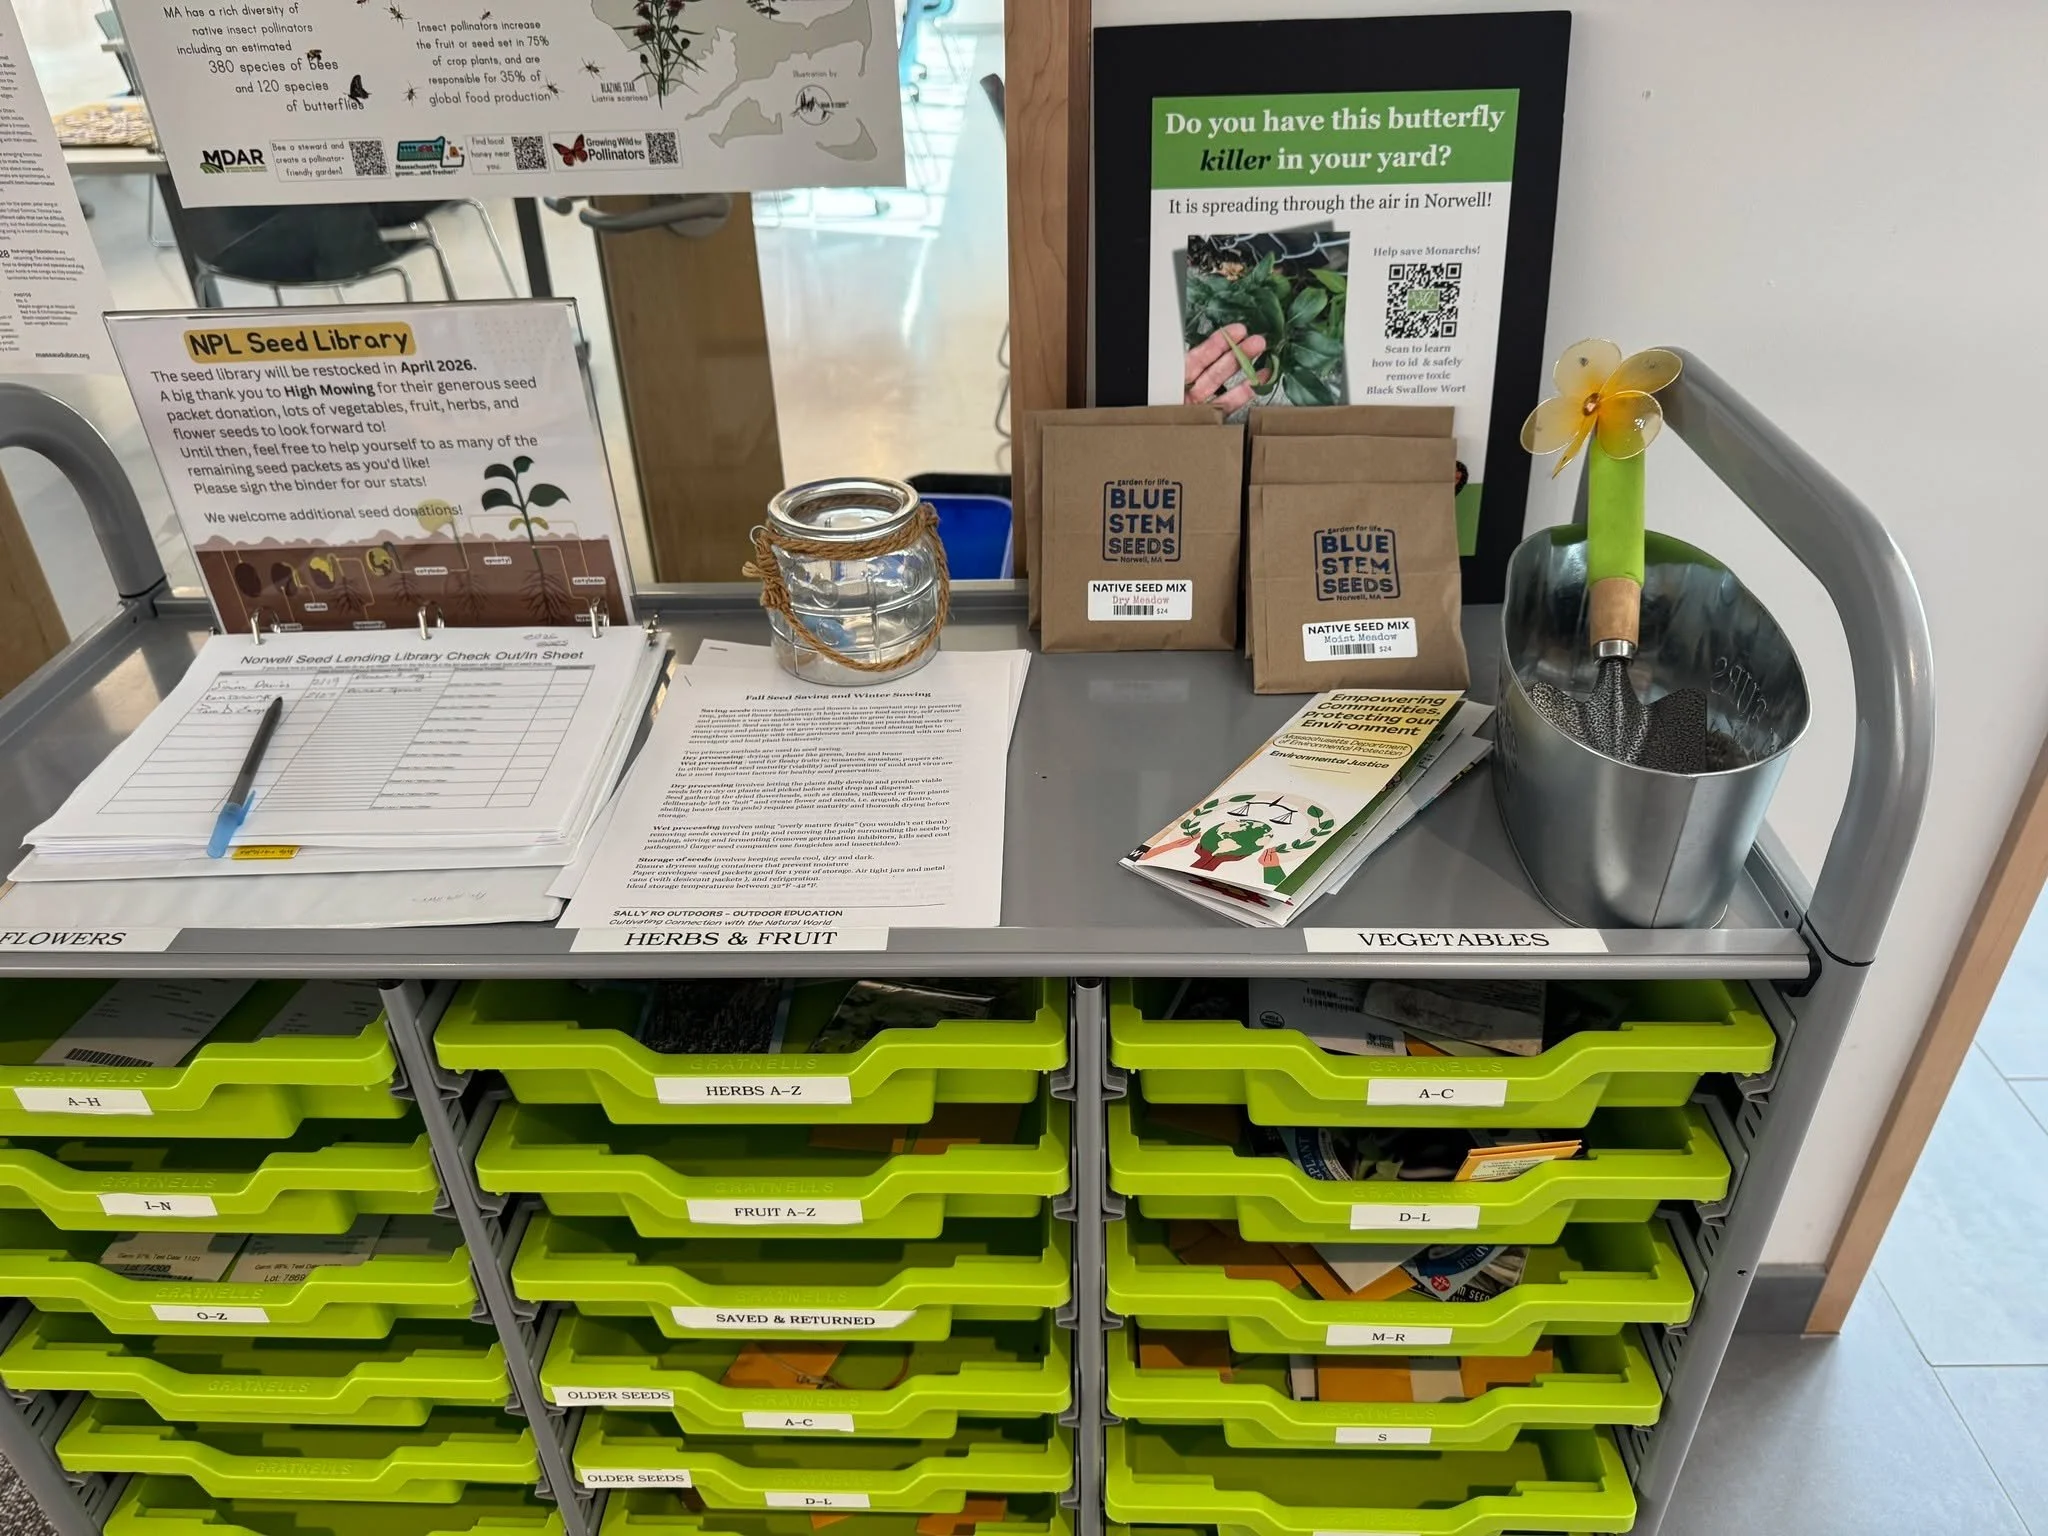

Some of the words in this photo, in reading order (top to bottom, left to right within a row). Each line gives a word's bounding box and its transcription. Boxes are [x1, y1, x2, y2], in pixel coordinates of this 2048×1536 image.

[417, 21, 446, 32] Insect
[451, 20, 498, 33] pollinators
[502, 21, 541, 30] increase
[209, 60, 234, 73] 380
[240, 60, 285, 75] species
[291, 58, 302, 70] of
[309, 58, 338, 70] bees
[236, 83, 253, 93] and
[258, 80, 279, 92] 120
[285, 82, 328, 95] species
[430, 94, 461, 107] global
[466, 92, 490, 103] food
[1165, 113, 1202, 135] Do
[1208, 115, 1255, 139] you
[1263, 110, 1324, 132] have
[1331, 108, 1381, 131] this
[1388, 104, 1505, 132] butterfly
[586, 138, 616, 148] Growing
[619, 137, 633, 146] Wild
[203, 149, 265, 170] MDAR
[588, 148, 645, 160] Pollinators
[1200, 149, 1271, 171] killer
[1277, 148, 1303, 169] in
[1310, 152, 1372, 174] your
[1378, 145, 1452, 173] yard?
[286, 167, 313, 177] friendly
[316, 167, 342, 177] garden!
[1169, 200, 1182, 214] It
[1186, 198, 1198, 213] is
[1202, 197, 1278, 216] spreading
[1283, 196, 1344, 212] through
[1350, 195, 1374, 209] the
[1379, 195, 1400, 208] air
[1405, 194, 1419, 208] in
[1425, 192, 1492, 207] Norwell!
[1373, 247, 1398, 257] Help
[1400, 248, 1422, 256] save
[1425, 246, 1480, 256] Monarchs!
[189, 333, 243, 356] NPL
[247, 331, 308, 353] Seed
[313, 329, 408, 354] Library
[151, 370, 177, 383] The
[181, 369, 213, 382] seed
[217, 367, 261, 382] library
[265, 365, 289, 379] will
[292, 364, 309, 378] be
[313, 361, 381, 377] restocked
[385, 362, 397, 374] in
[401, 360, 435, 376] April
[438, 359, 477, 371] 2026.
[1367, 386, 1393, 395] Black
[1396, 385, 1438, 394] Swallow
[167, 409, 213, 423] packet
[215, 407, 281, 419] donation,
[283, 405, 309, 417] lots
[313, 403, 326, 416] of
[330, 402, 408, 417] vegetables,
[410, 400, 445, 413] fruit,
[447, 398, 491, 411] herbs,
[494, 397, 519, 409] and
[1118, 479, 1142, 487] garden
[1110, 488, 1176, 509] BLUE
[1109, 514, 1174, 533] STEM
[1109, 538, 1175, 555] SEEDS
[1321, 535, 1389, 553] BLUE
[1322, 556, 1391, 574] STEM
[1093, 584, 1132, 592] NATIVE
[1136, 584, 1162, 592] SEED
[1166, 584, 1186, 592] MIX
[1323, 578, 1393, 593] SEEDS
[1113, 596, 1130, 606] Dry
[1133, 595, 1169, 604] Meadow
[1308, 623, 1351, 634] NATIVE
[1354, 622, 1384, 632] SEED
[1388, 621, 1409, 630] MIX
[1324, 635, 1355, 643] Moist
[1358, 633, 1397, 641] Meadow
[241, 656, 293, 664] Norwell
[296, 654, 333, 663] Seed
[336, 653, 391, 663] Lending
[394, 651, 443, 661] Library
[446, 651, 491, 660] Check
[496, 651, 538, 660] Out/In
[542, 651, 584, 660] Sheet
[1332, 694, 1447, 706] Empowering
[1317, 702, 1440, 715] Communities,
[1302, 711, 1401, 724] Protecting
[1406, 717, 1440, 725] our
[1301, 720, 1420, 735] Environment
[1283, 734, 1349, 745] Massachusetts
[1351, 740, 1408, 750] Department
[1291, 740, 1352, 750] Environmental
[1354, 746, 1402, 756] Protection
[1270, 751, 1349, 764] Environmental
[1347, 760, 1390, 768] Justice
[0, 932, 127, 945] FLOWERS
[624, 932, 719, 945] HERBS
[727, 932, 748, 945] &
[757, 932, 838, 944] FRUIT
[1358, 933, 1550, 948] VEGETABLES
[24, 1071, 148, 1083] GRATNELLS
[706, 1085, 763, 1097] HERBS
[734, 1207, 781, 1217] FRUIT
[716, 1314, 768, 1324] SAVED
[774, 1315, 785, 1324] &
[790, 1315, 875, 1325] RETURNED
[208, 1380, 310, 1393] GRATNELLS
[567, 1391, 616, 1400] OLDER
[621, 1391, 671, 1400] SEEDS
[1378, 1433, 1387, 1441] S
[588, 1474, 634, 1483] OLDER
[638, 1474, 684, 1483] SEEDS
